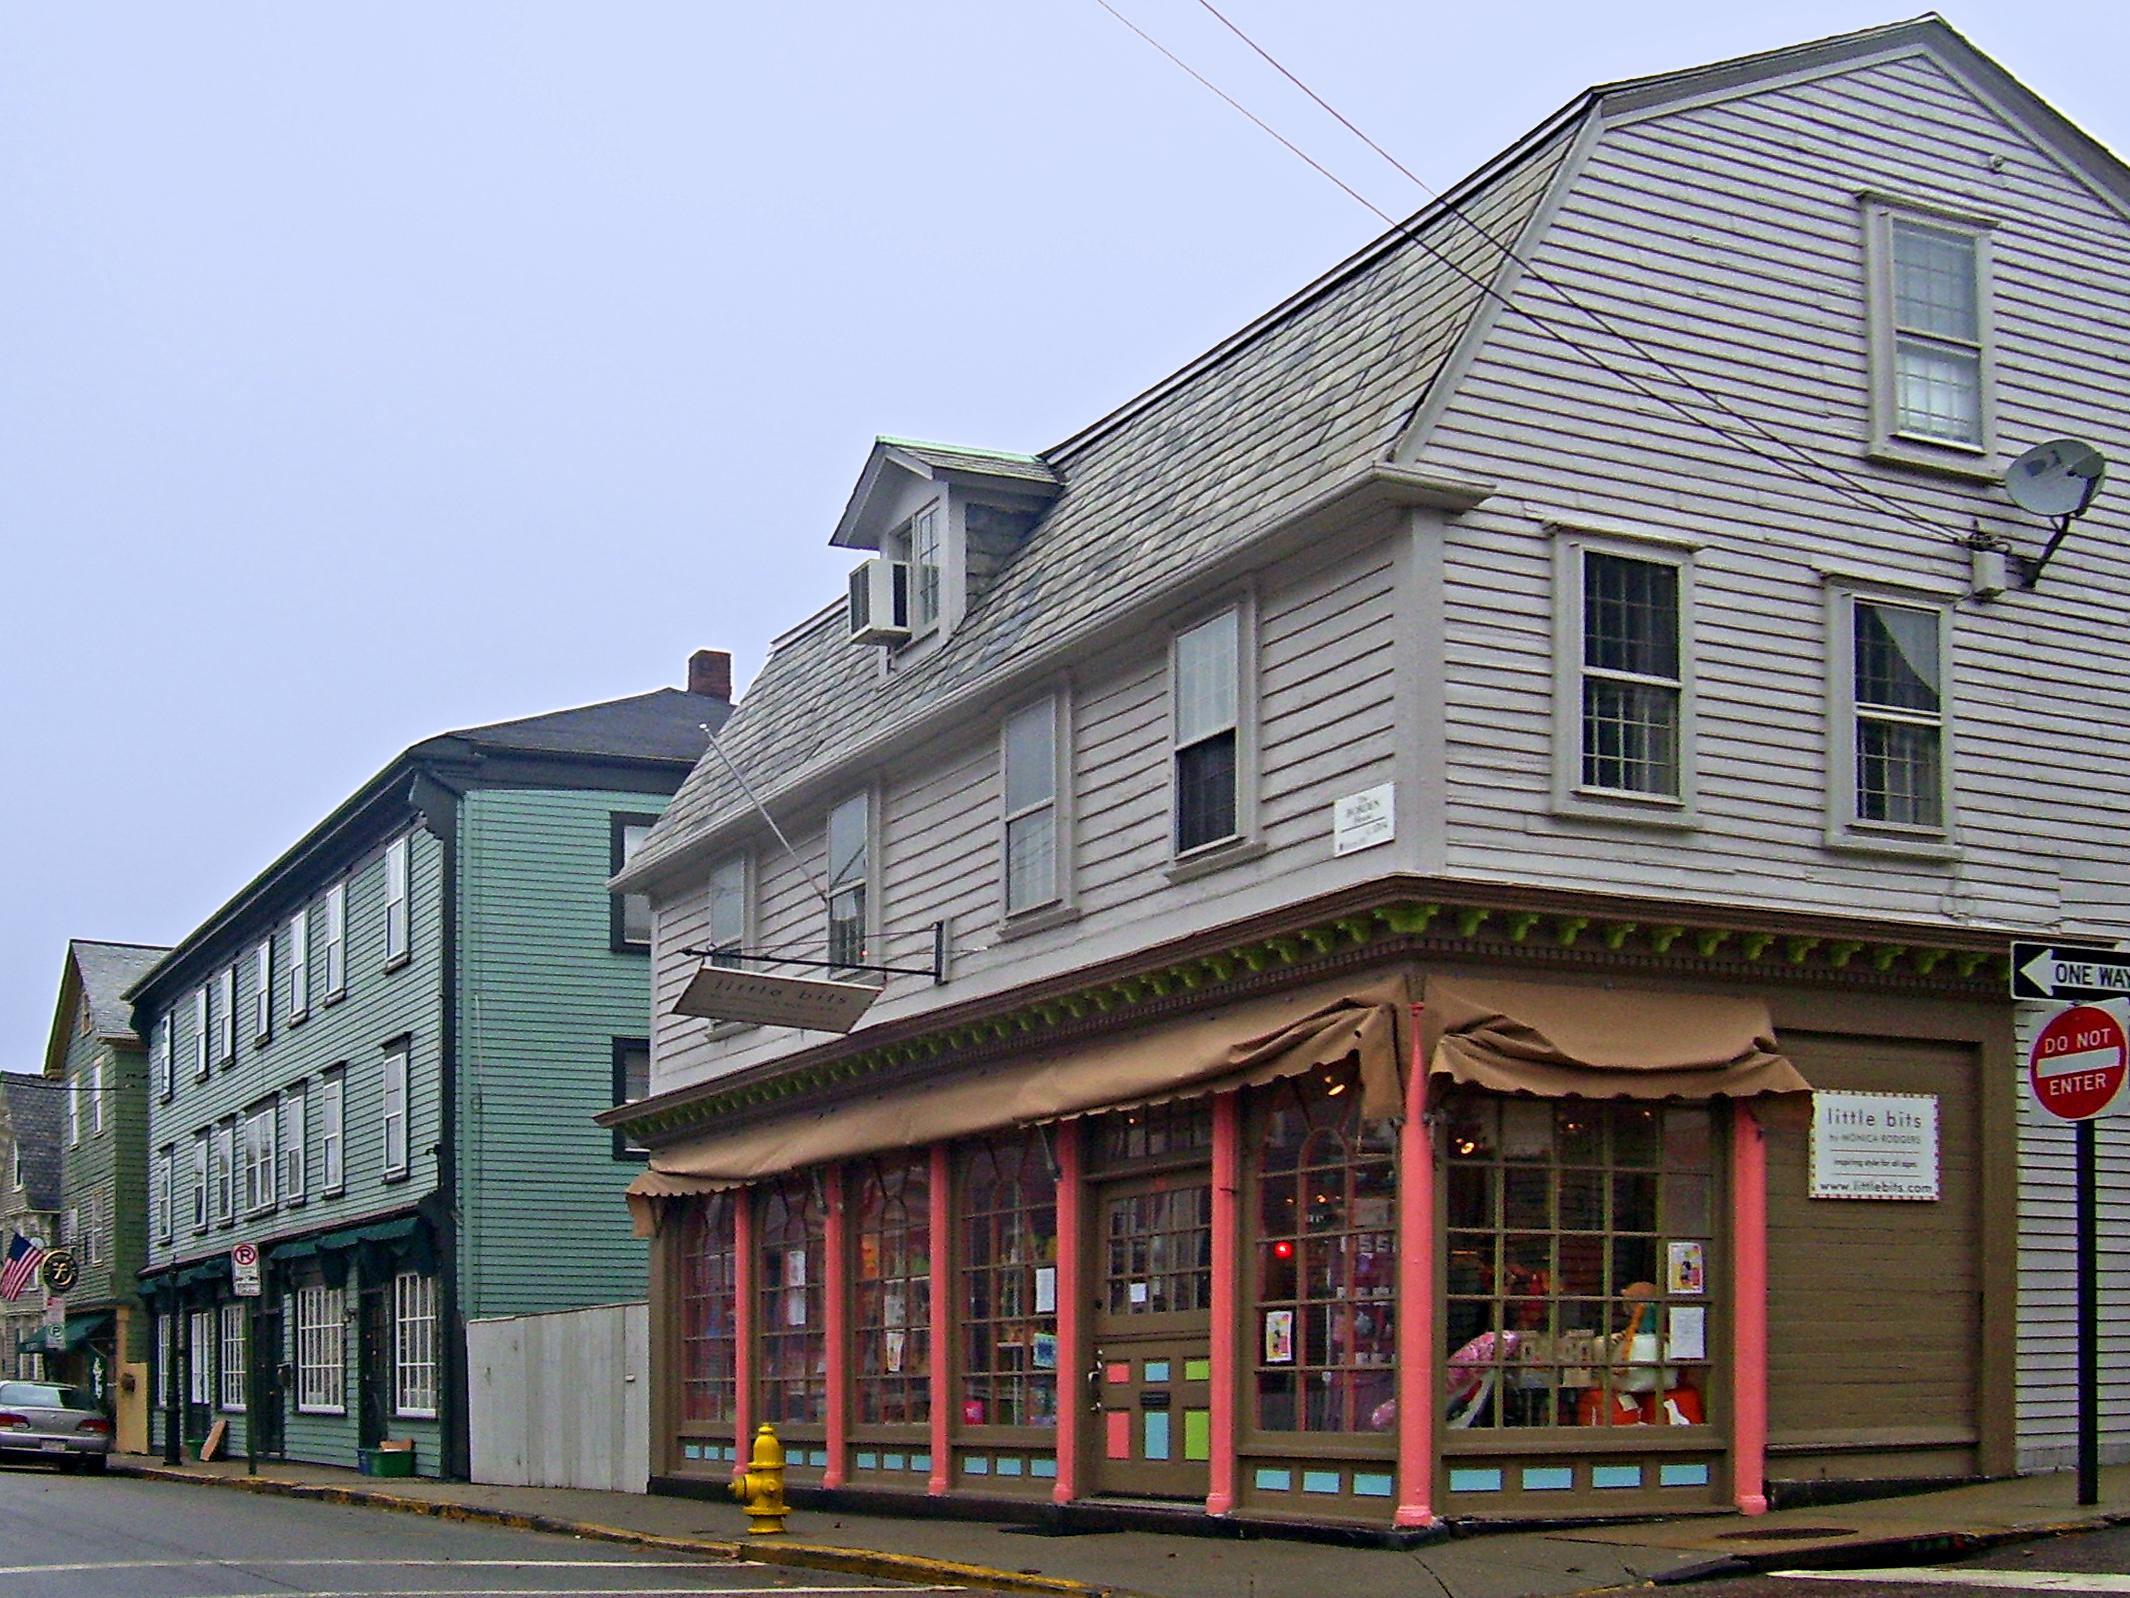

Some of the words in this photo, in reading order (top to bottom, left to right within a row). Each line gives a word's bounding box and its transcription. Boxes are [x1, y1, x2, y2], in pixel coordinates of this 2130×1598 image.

[2055, 963, 2094, 986] ONE
[2045, 1035, 2069, 1054] DO
[2076, 1028, 2112, 1049] NOT
[2049, 1072, 2107, 1097] ENTER
[1828, 1107, 1876, 1127] little
[1886, 1109, 1922, 1129] bits
